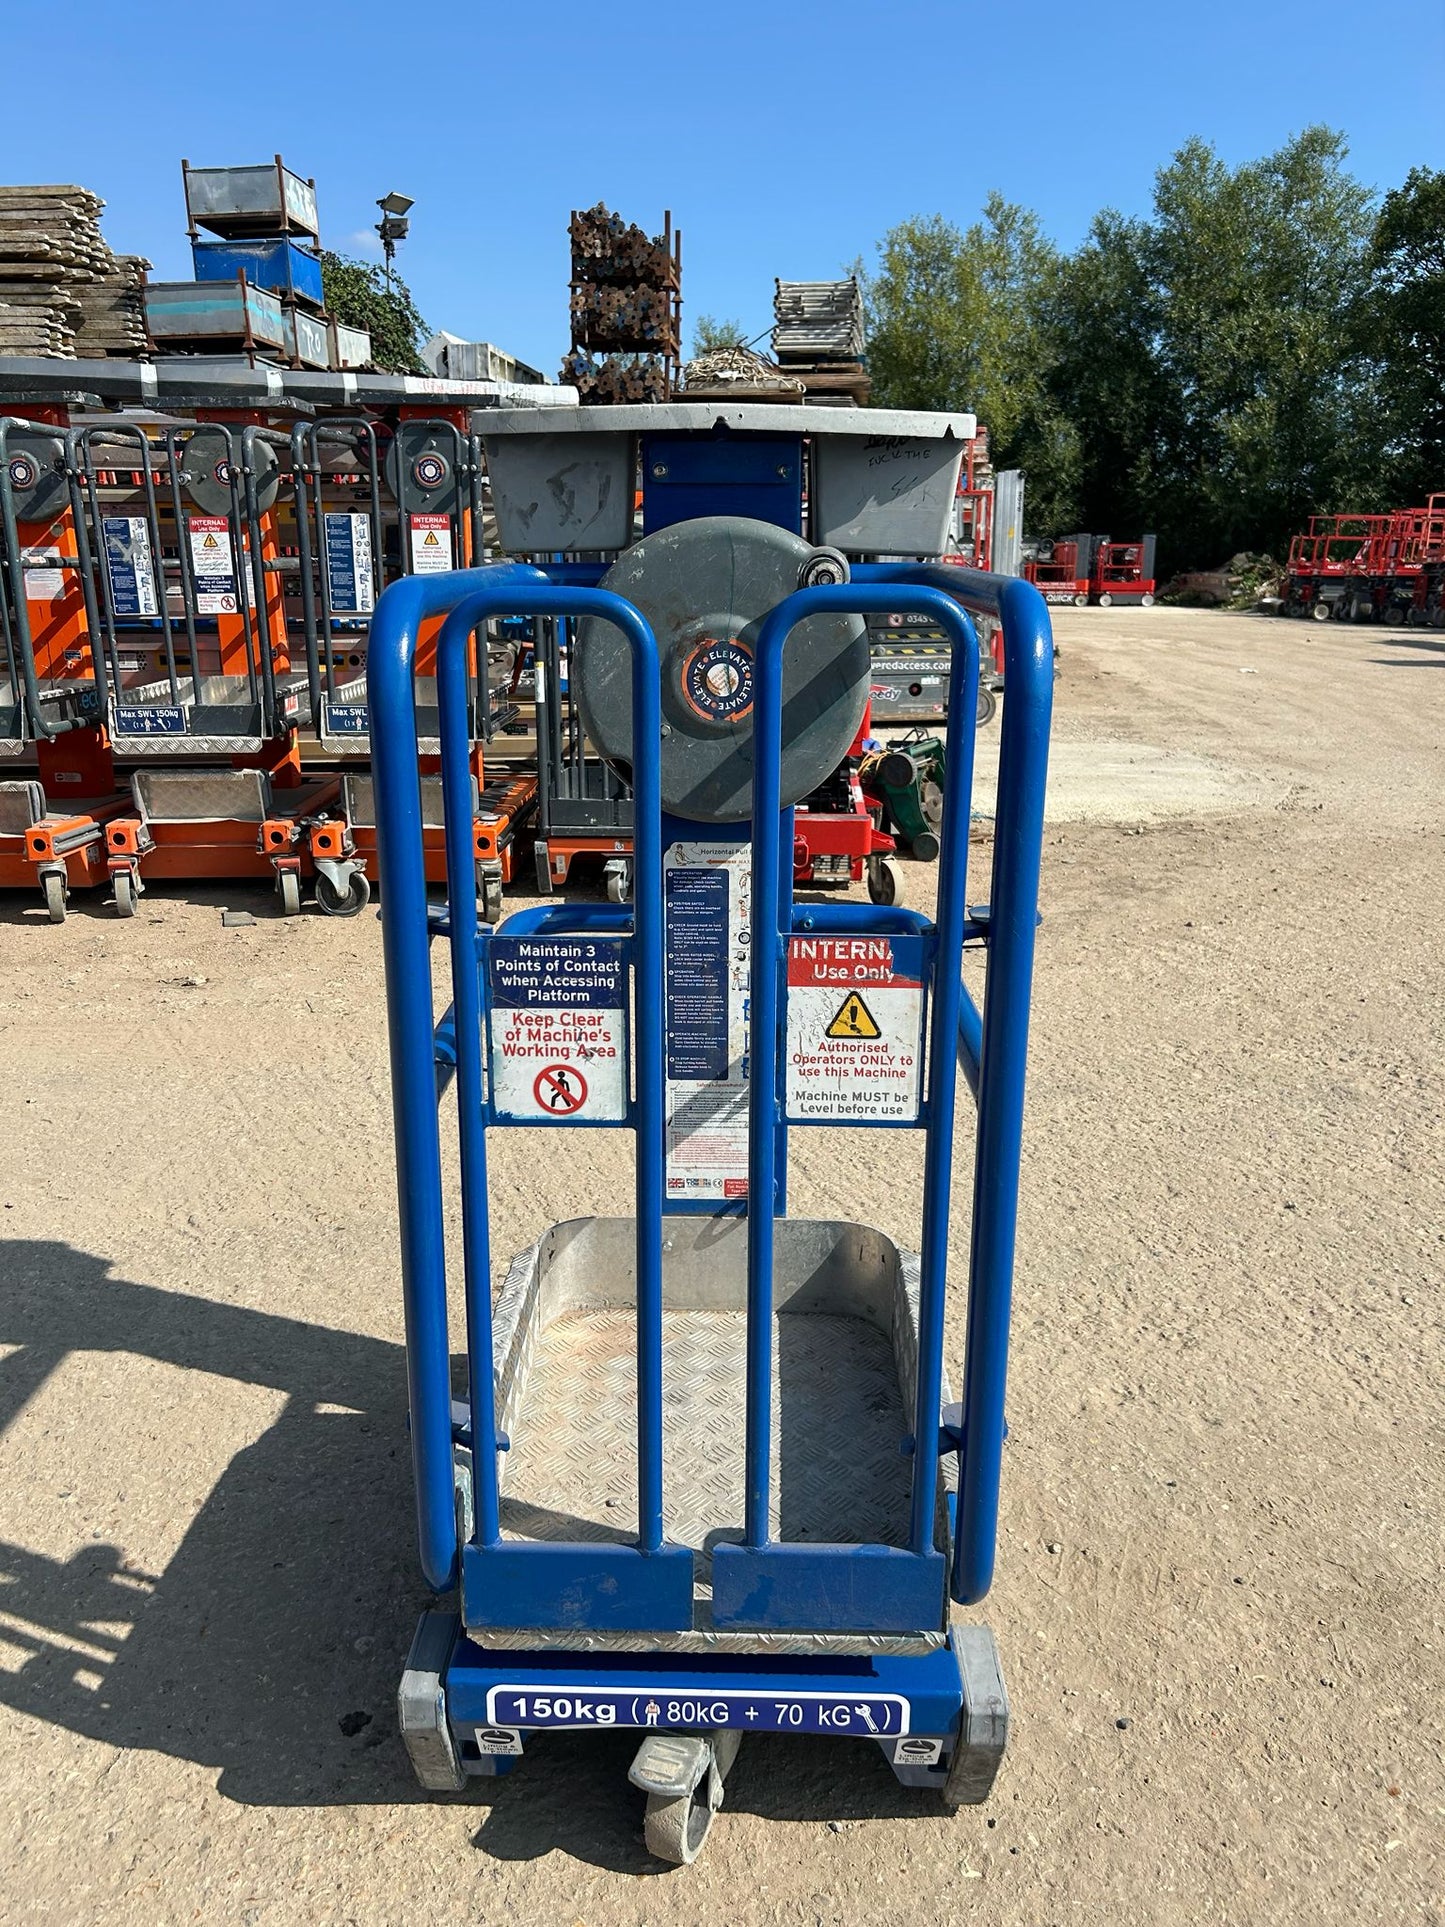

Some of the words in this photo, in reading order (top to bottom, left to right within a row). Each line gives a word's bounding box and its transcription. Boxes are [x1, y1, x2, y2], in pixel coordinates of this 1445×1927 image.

[413, 516, 447, 524] INTERNAL
[906, 615, 928, 623] 0345
[709, 650, 750, 673] ELEVATE
[692, 662, 712, 706] ELEVATE
[718, 680, 752, 710] ELEVATE
[138, 710, 155, 718] SWL
[156, 709, 179, 718] 150kg
[332, 708, 349, 716] Max
[350, 708, 368, 716] SWL
[519, 944, 581, 957] Maintain
[586, 945, 596, 957] 3
[793, 940, 893, 960] INTERN
[496, 959, 541, 971] Points
[545, 959, 559, 971] of
[564, 960, 620, 972] Contact
[814, 964, 848, 979] Use
[854, 964, 894, 983] Only
[502, 975, 538, 986] when
[543, 975, 615, 989] Accessing
[528, 990, 590, 1001] Platform
[512, 1012, 554, 1029] Keep
[560, 1012, 604, 1027] Clear
[505, 1029, 522, 1041] of
[527, 1029, 612, 1042] Machine's
[502, 1043, 570, 1060] Working
[818, 1042, 888, 1053] Authorised
[792, 1054, 855, 1066] Operators
[860, 1055, 896, 1066] ONLY
[900, 1057, 913, 1066] to
[798, 1068, 820, 1077] use
[825, 1067, 849, 1077] this
[854, 1067, 907, 1078] Machine
[795, 1091, 847, 1102] Machine
[852, 1092, 890, 1102] MUST
[894, 1093, 909, 1102] be
[800, 1103, 833, 1113] Level
[838, 1104, 877, 1114] before
[881, 1106, 903, 1115] use
[512, 1698, 616, 1724] 150kg
[667, 1701, 729, 1723] 80kG
[774, 1704, 803, 1725] 70
[818, 1705, 850, 1726] kG
